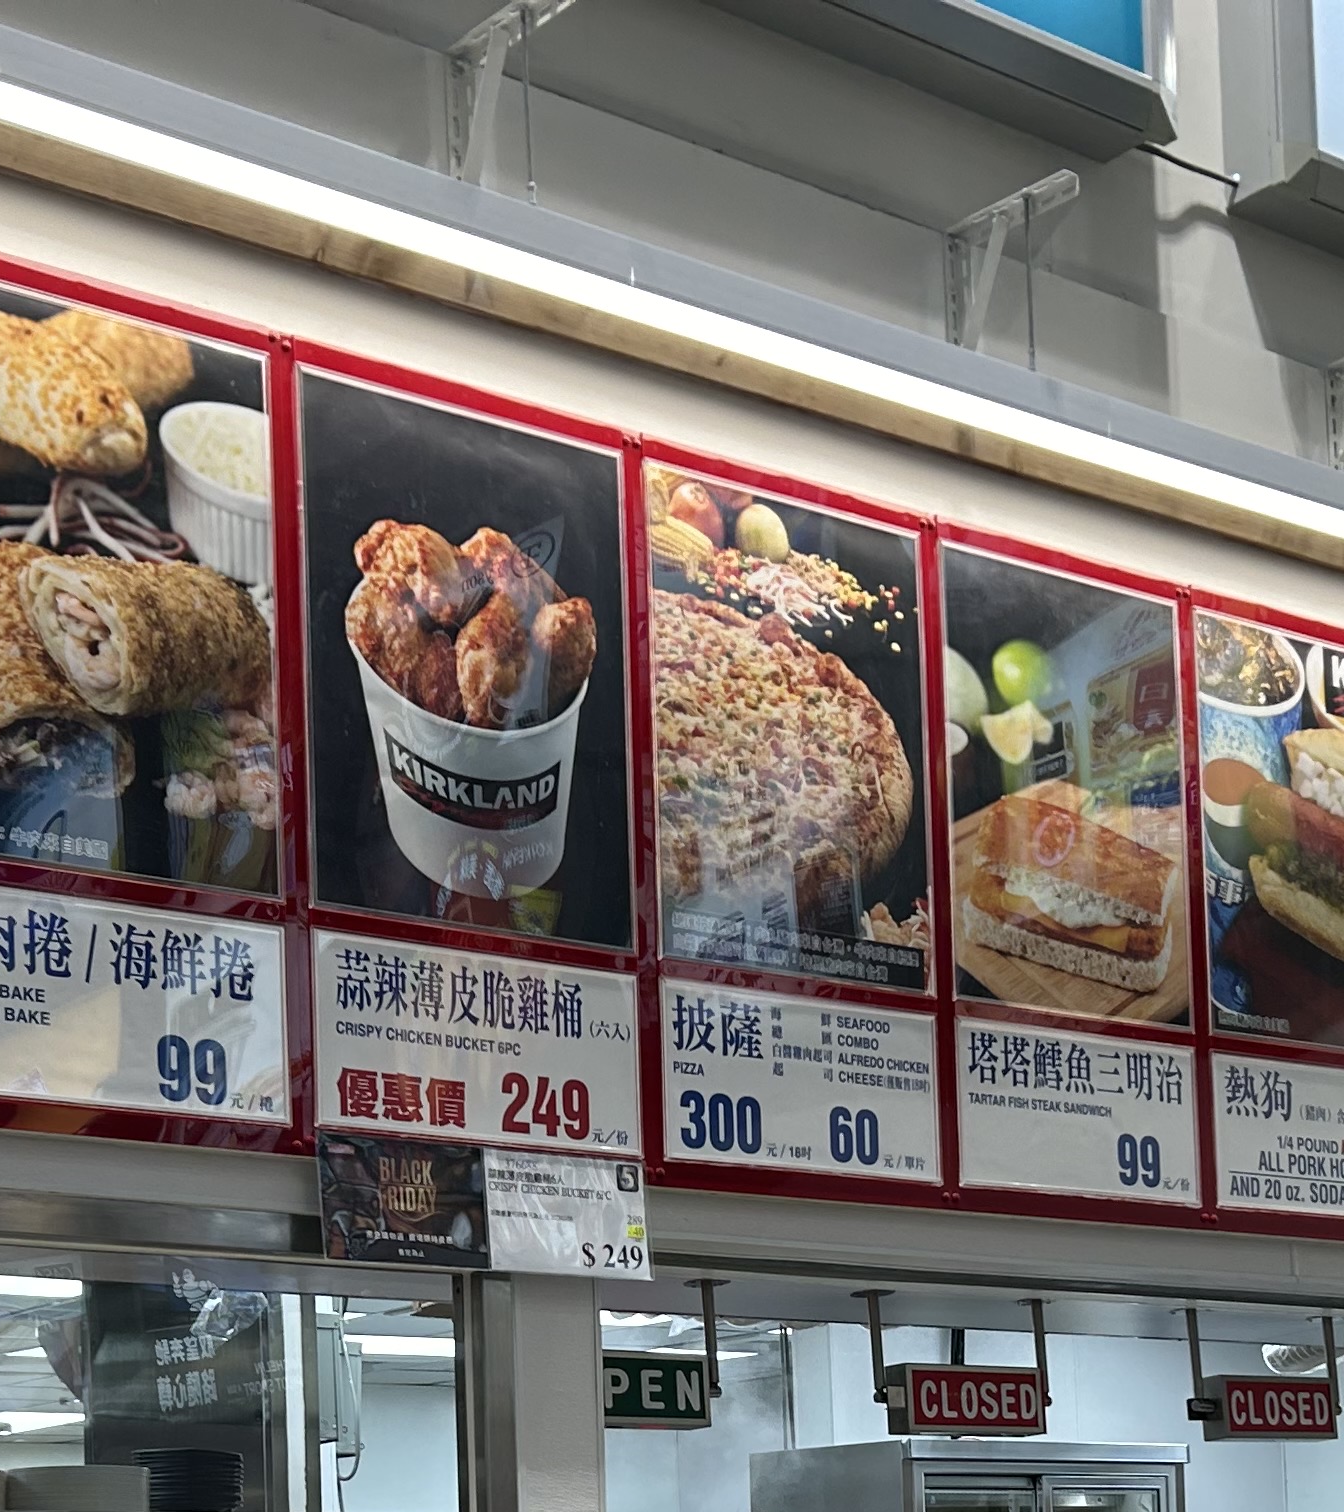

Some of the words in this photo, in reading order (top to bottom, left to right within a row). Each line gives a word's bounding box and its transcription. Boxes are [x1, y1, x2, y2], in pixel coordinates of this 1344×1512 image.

[391, 740, 556, 811] KIRKLAND
[0, 984, 45, 1003] BAKE
[335, 948, 583, 1041] 蒜辣薄皮脆雞桶
[4, 1007, 51, 1026] BAKE
[671, 995, 764, 1060] 披薩
[836, 1015, 890, 1034] SEAFOOD
[335, 1021, 382, 1041] CRISPY
[386, 1026, 442, 1047] CHICKEN
[445, 1035, 495, 1054] BUCKET
[498, 1042, 521, 1056] 6PC
[837, 1034, 879, 1050] COMBO
[157, 1034, 229, 1107] 99
[673, 1060, 704, 1076] PIZZA
[838, 1052, 884, 1069] ALFREDO
[886, 1058, 929, 1075] CHICKEN
[968, 1032, 1183, 1105] 塔塔鱈魚三明治
[336, 1067, 467, 1129] 優惠價
[501, 1072, 590, 1141] 249
[968, 1092, 1006, 1108] TARTAR
[1008, 1097, 1030, 1110] FISH
[1031, 1099, 1062, 1113] STEAK
[1063, 1102, 1112, 1119] SANDWICH
[1224, 1065, 1293, 1122] 熱狗
[679, 1090, 761, 1154] 300
[829, 1106, 879, 1165] 60
[1117, 1133, 1161, 1188] 99
[1277, 1135, 1295, 1151] 1/4
[1297, 1138, 1339, 1155] POUND
[378, 1156, 434, 1186] BLACK
[1258, 1151, 1284, 1173] ALL
[1287, 1154, 1326, 1177] PORK
[488, 1182, 518, 1193] CRISPY
[520, 1184, 560, 1196] CHICKEN
[561, 1187, 594, 1199] BUCKET
[1230, 1175, 1260, 1198] AND
[1264, 1178, 1283, 1201] 20
[1285, 1185, 1306, 1203] oz.
[602, 1243, 643, 1270] 249
[921, 1379, 1037, 1420] CLOSED
[1230, 1388, 1330, 1427] CLOSED
